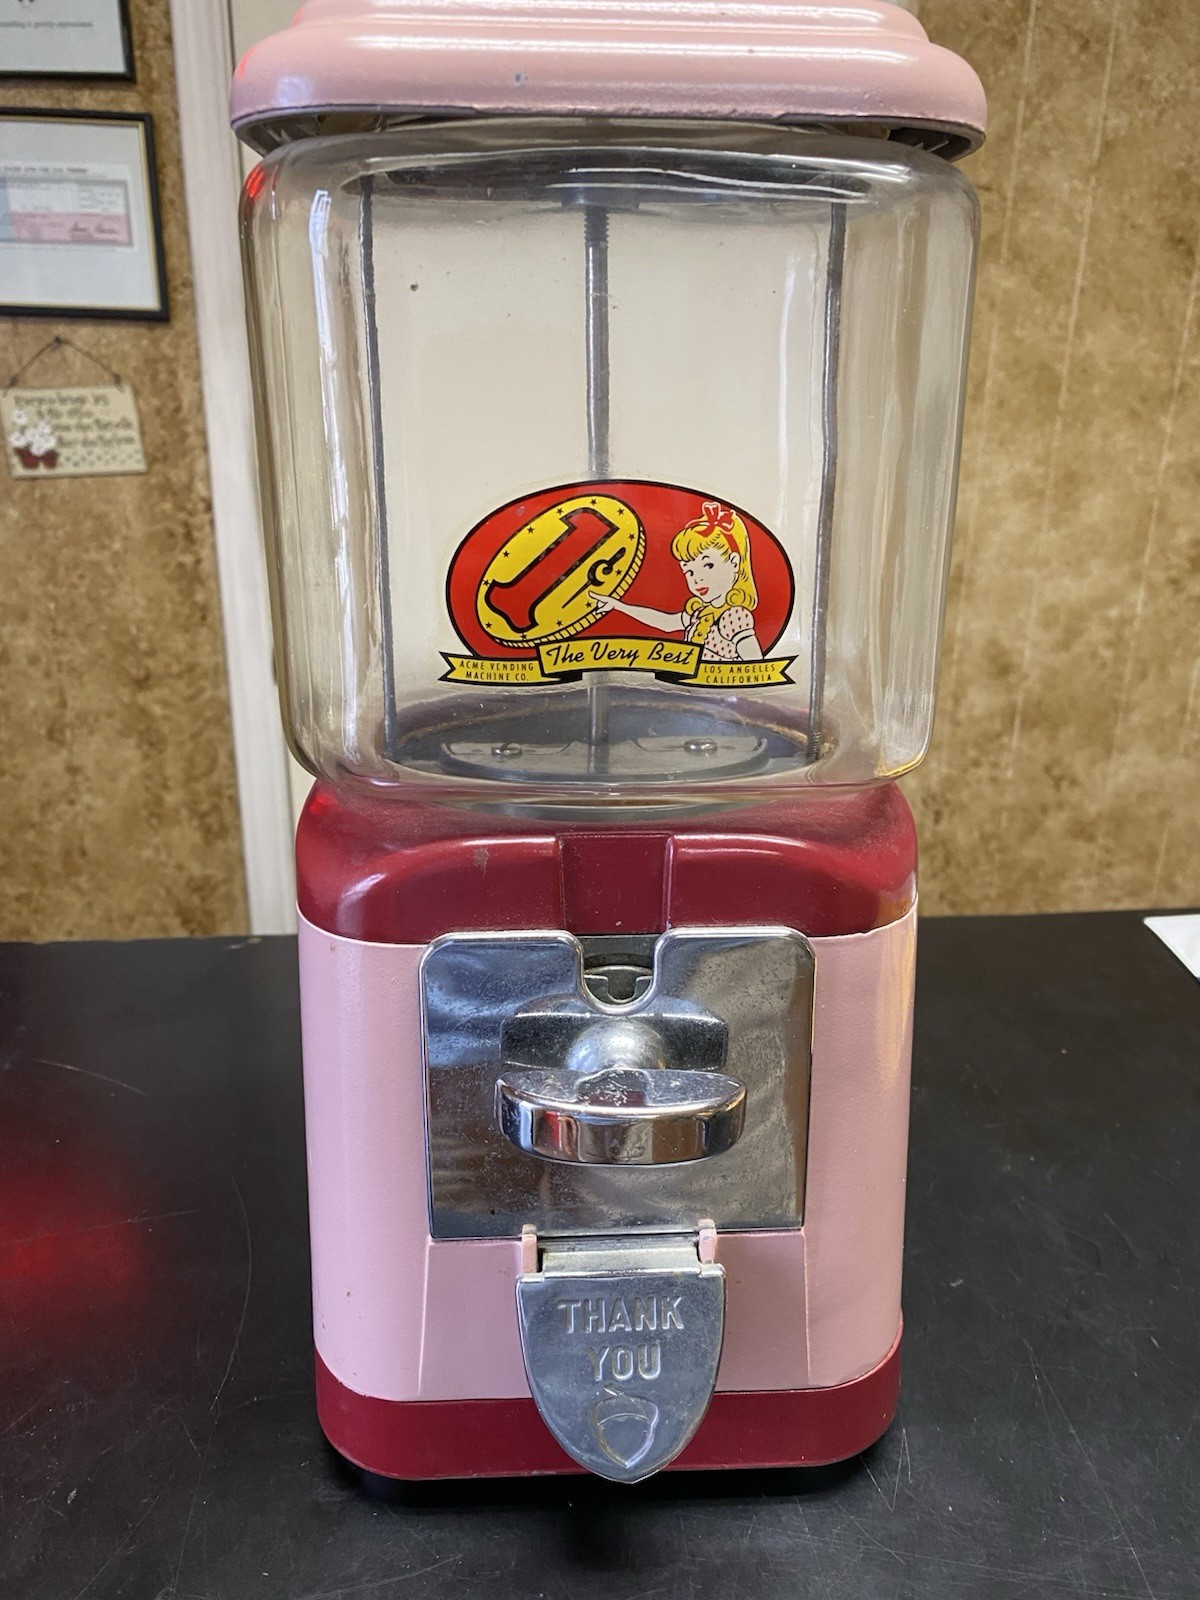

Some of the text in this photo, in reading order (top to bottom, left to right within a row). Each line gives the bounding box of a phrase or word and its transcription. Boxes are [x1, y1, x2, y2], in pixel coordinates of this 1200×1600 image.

[546, 640, 695, 667] The Very Best
[459, 660, 534, 672] ACME VENDING
[704, 663, 776, 674] LOS ANGELES
[465, 671, 530, 682] MACHINE CO.
[705, 674, 773, 684] CALIFORNIA
[556, 1296, 685, 1335] THANK
[586, 1343, 662, 1382] YOU
